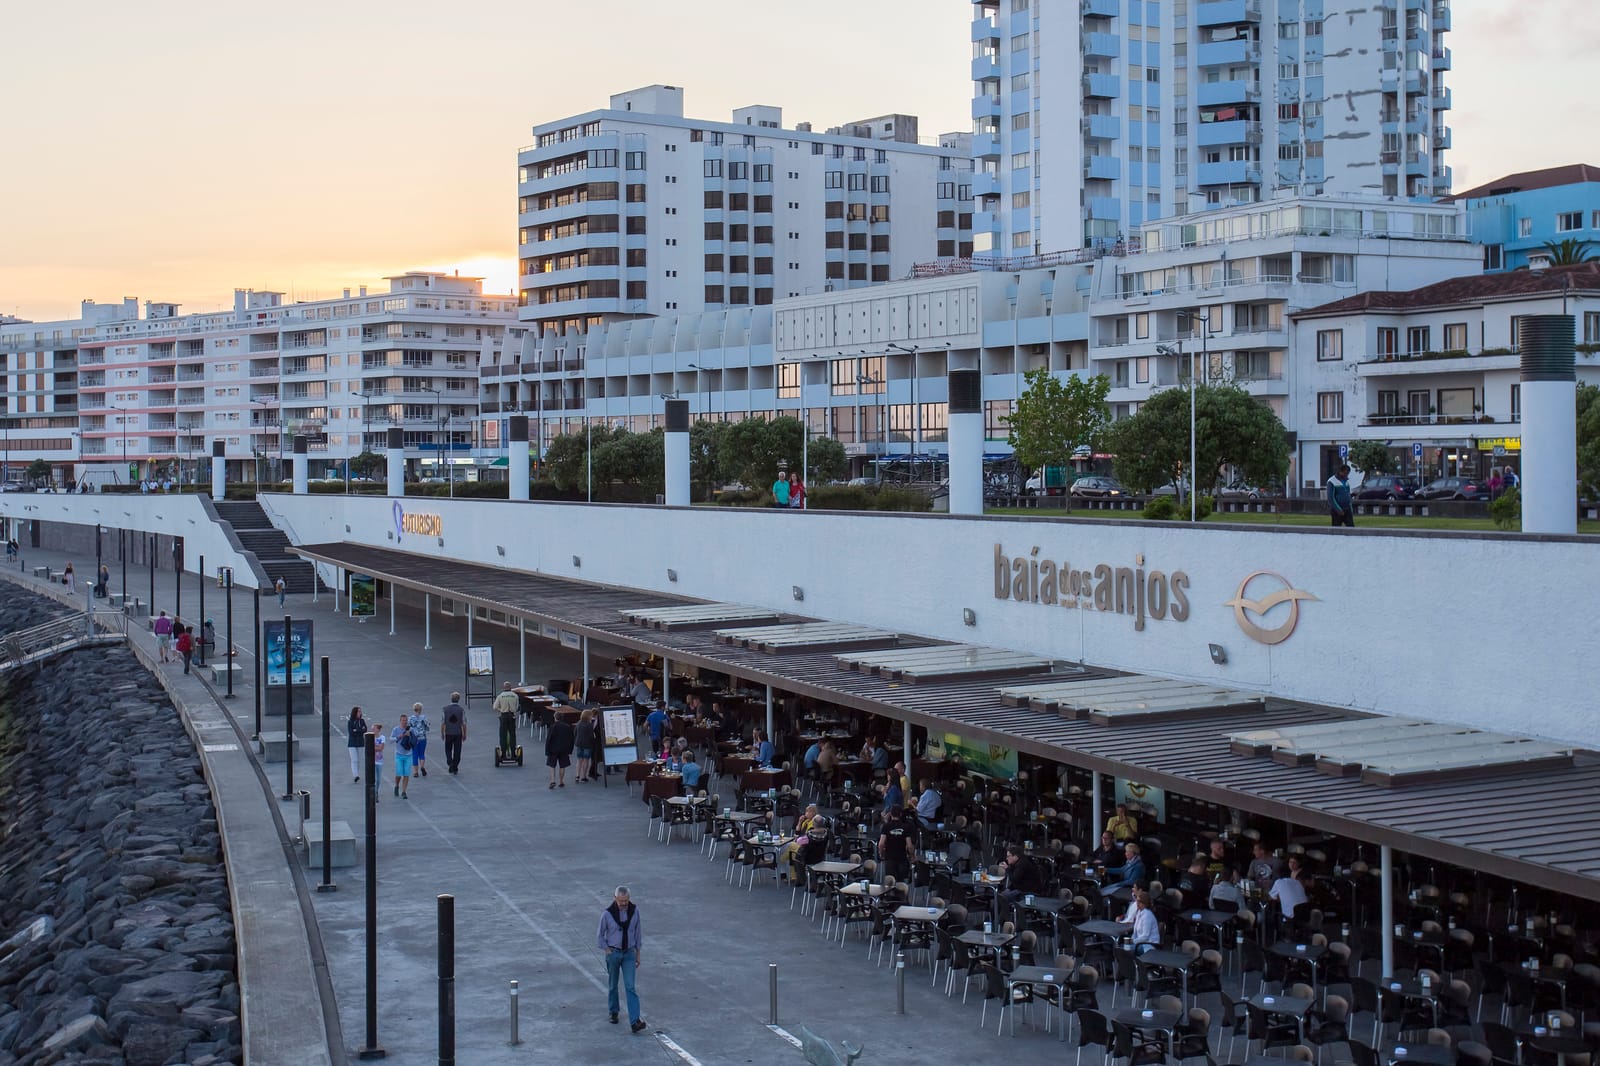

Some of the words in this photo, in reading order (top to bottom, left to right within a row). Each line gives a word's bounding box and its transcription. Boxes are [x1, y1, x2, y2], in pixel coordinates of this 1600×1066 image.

[402, 512, 442, 536] FUTURISMO
[994, 543, 1058, 604] baía
[1059, 561, 1092, 597] dos
[1094, 552, 1190, 632] anjos
